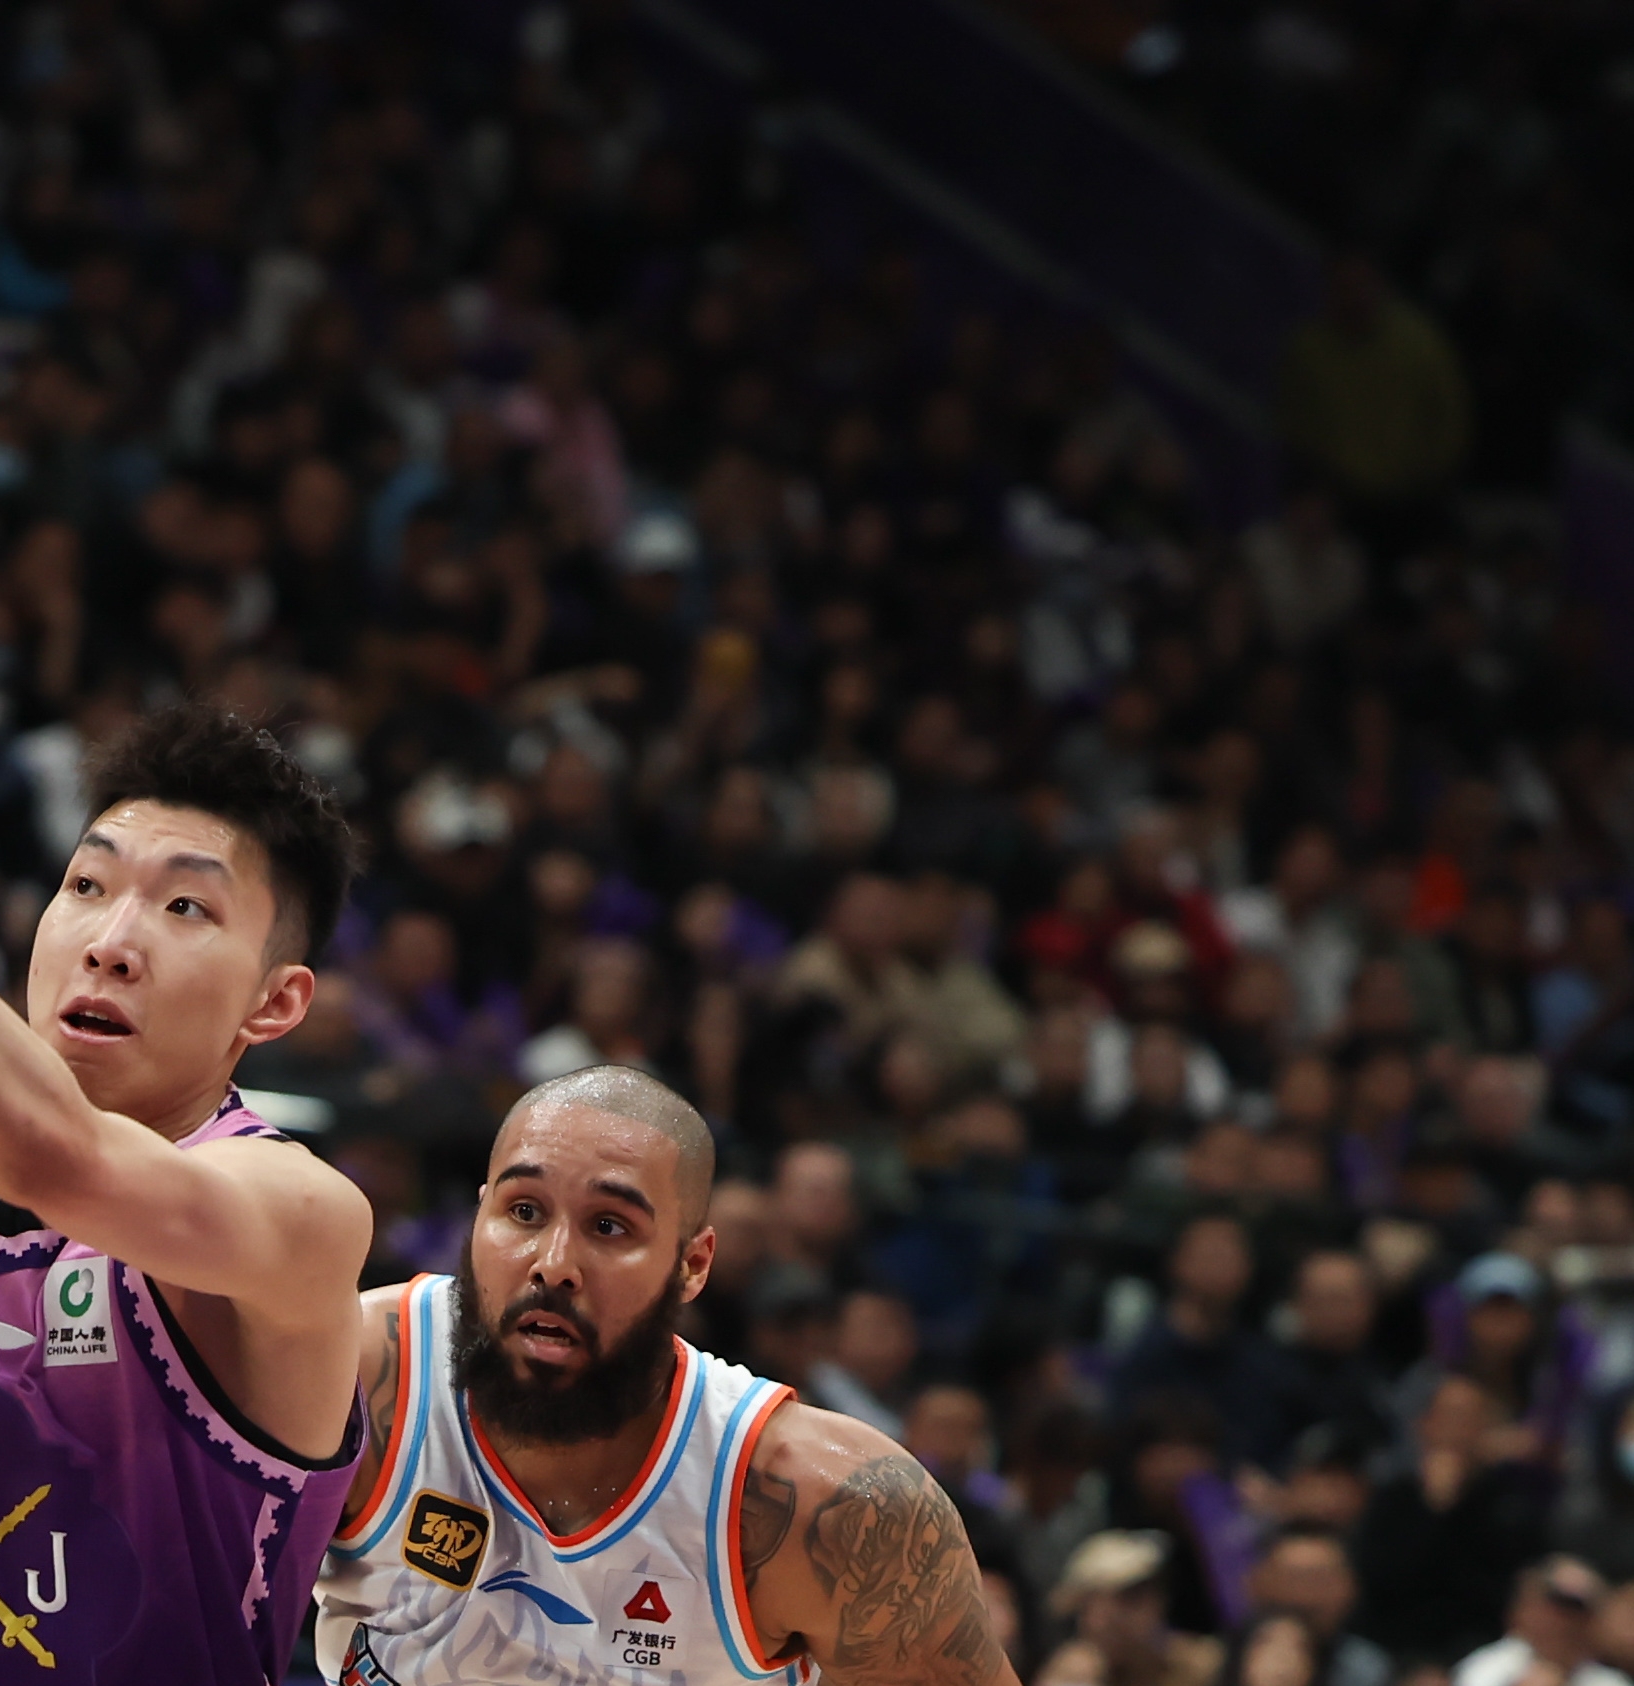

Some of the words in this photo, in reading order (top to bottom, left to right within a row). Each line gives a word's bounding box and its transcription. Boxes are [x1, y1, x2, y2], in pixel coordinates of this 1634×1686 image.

[48, 1325, 107, 1344] 中国人寿
[46, 1345, 78, 1356] CHINA
[81, 1343, 108, 1354] LIFE
[611, 1628, 677, 1651] 广发银行
[622, 1648, 661, 1666] CGB
